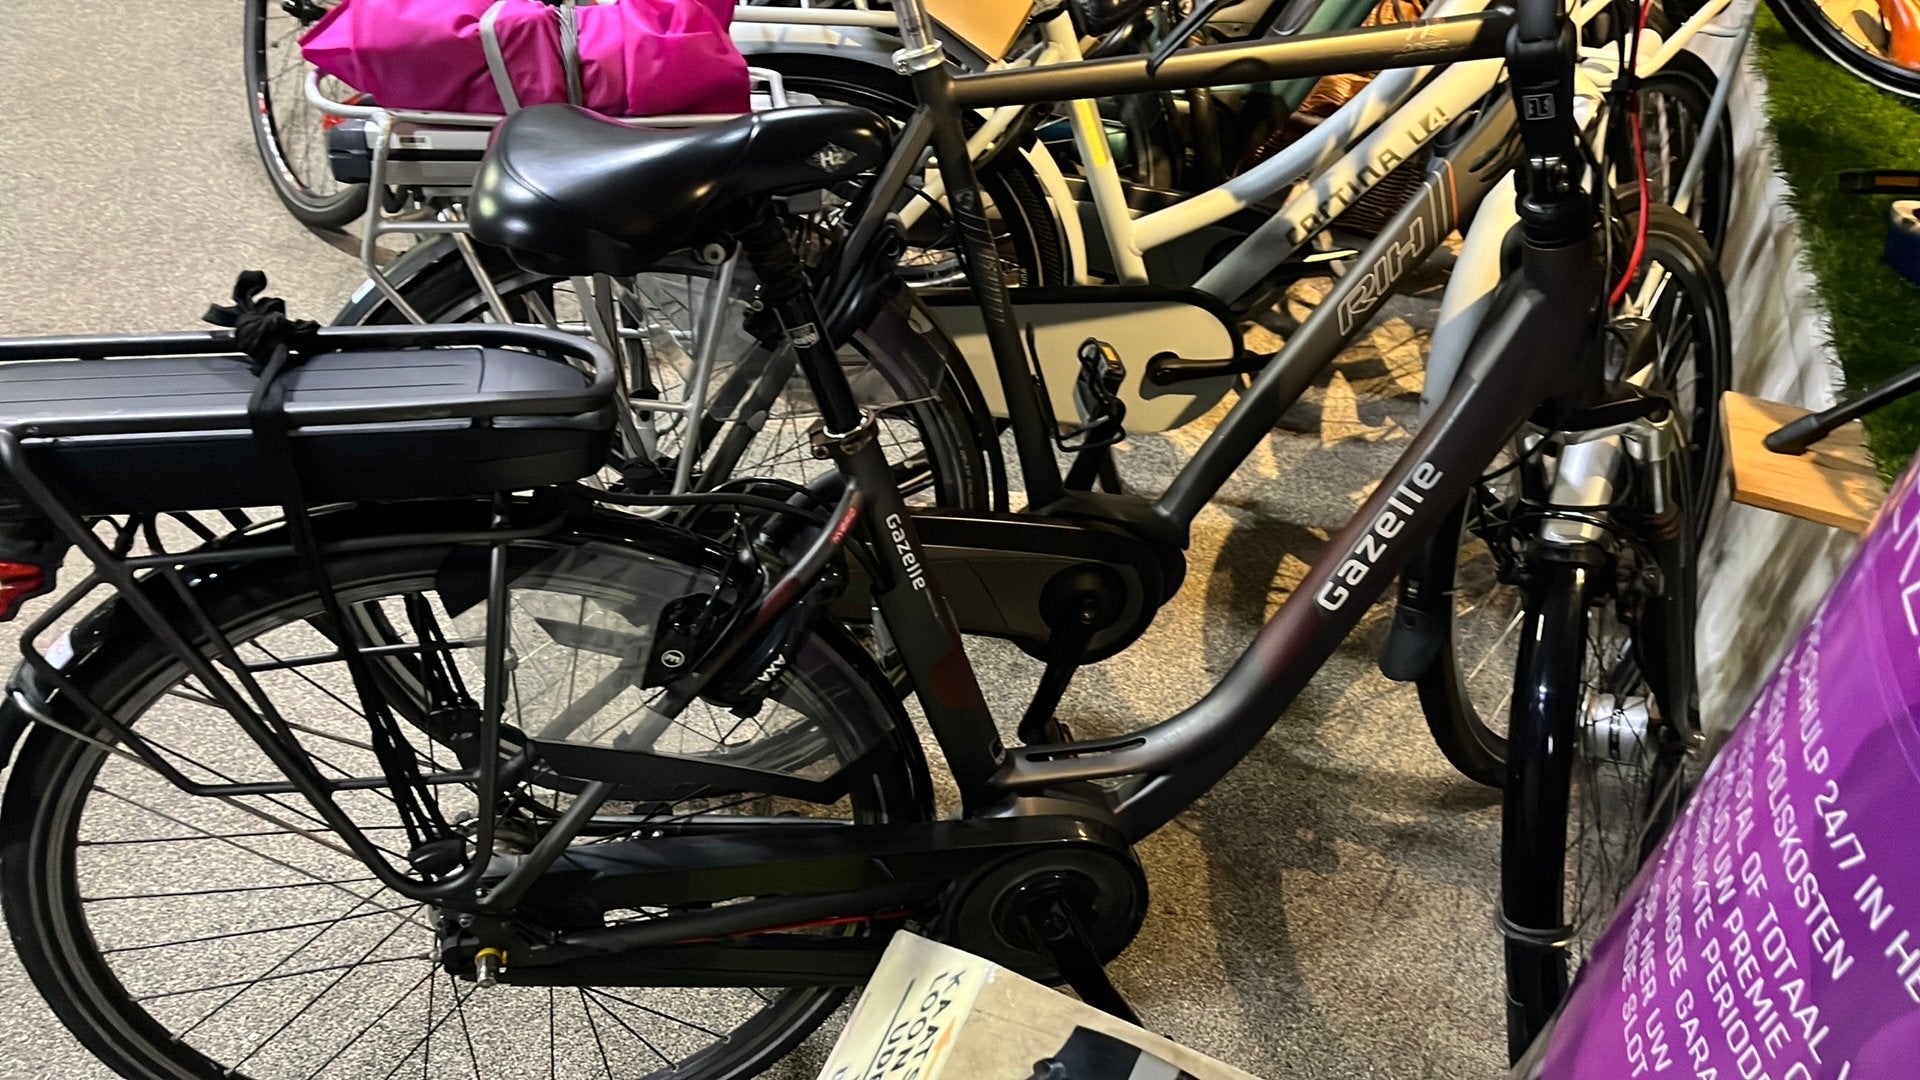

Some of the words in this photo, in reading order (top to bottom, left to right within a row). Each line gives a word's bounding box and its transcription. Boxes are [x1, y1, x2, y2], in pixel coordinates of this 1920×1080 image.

[1336, 216, 1426, 337] RIH
[886, 513, 927, 591] Gazelle
[1317, 462, 1444, 611] Gazelle
[757, 654, 786, 682] AXA
[1713, 841, 1737, 904] UW
[1766, 739, 1854, 981] POLISKOSTEN
[1814, 779, 1867, 869] 24/7
[1853, 874, 1895, 931] IN
[1640, 928, 1657, 1007] HIER
[1701, 937, 1771, 1080] PERIOD
[1722, 906, 1791, 1059] PREMIE
[1741, 850, 1768, 898] OF
[1757, 902, 1830, 1064] TOTAAL
[890, 973, 948, 1072] LOON
[1622, 993, 1649, 1078] SLOT
[1646, 1007, 1673, 1072] UW
